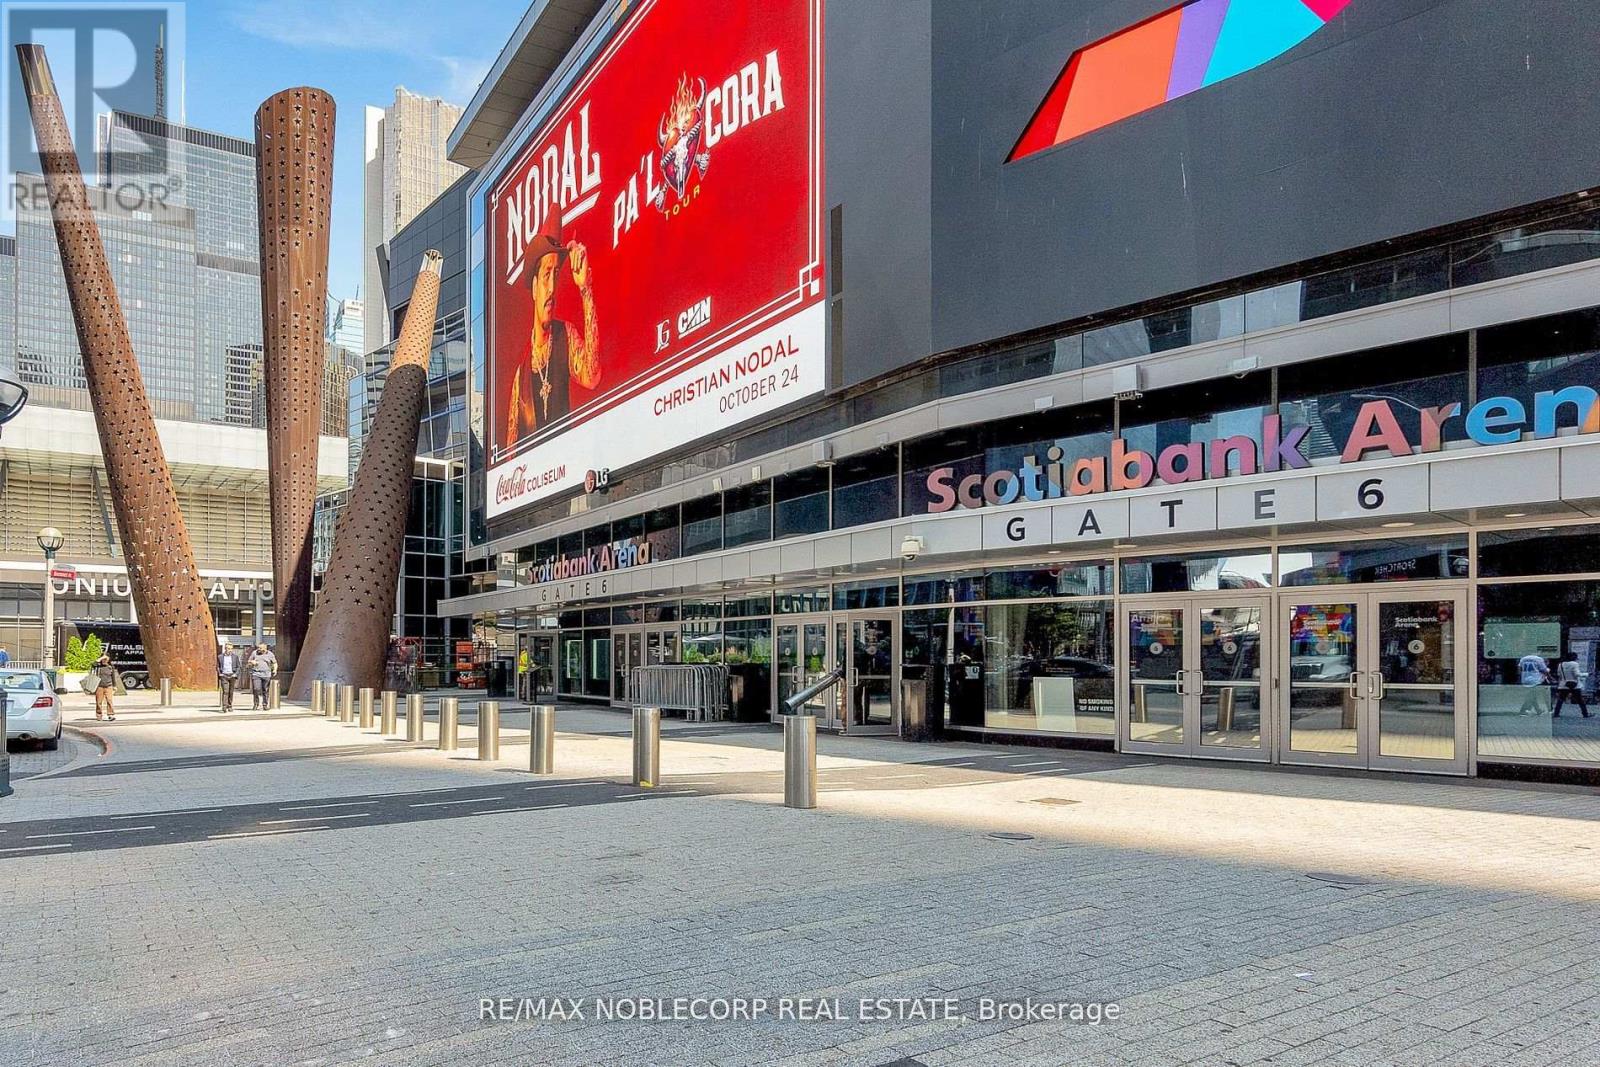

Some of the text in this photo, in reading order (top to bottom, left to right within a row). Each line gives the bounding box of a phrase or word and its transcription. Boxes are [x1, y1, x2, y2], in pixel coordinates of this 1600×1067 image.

[612, 48, 786, 250] PA'L CORA
[506, 100, 602, 276] NODAL
[664, 184, 701, 221] TOUR
[654, 334, 800, 416] CHRISTIAN NODAL
[719, 364, 799, 414] OCTOBER 24
[927, 385, 1600, 514] Scotiabank Aren
[526, 464, 567, 493] COLISEUM
[595, 468, 610, 487] LG
[1357, 478, 1384, 510] 6
[527, 540, 652, 584] Scotiabank Arena
[52, 571, 132, 597] UNIO
[601, 579, 608, 594] 6
[1413, 643, 1420, 653] 6
